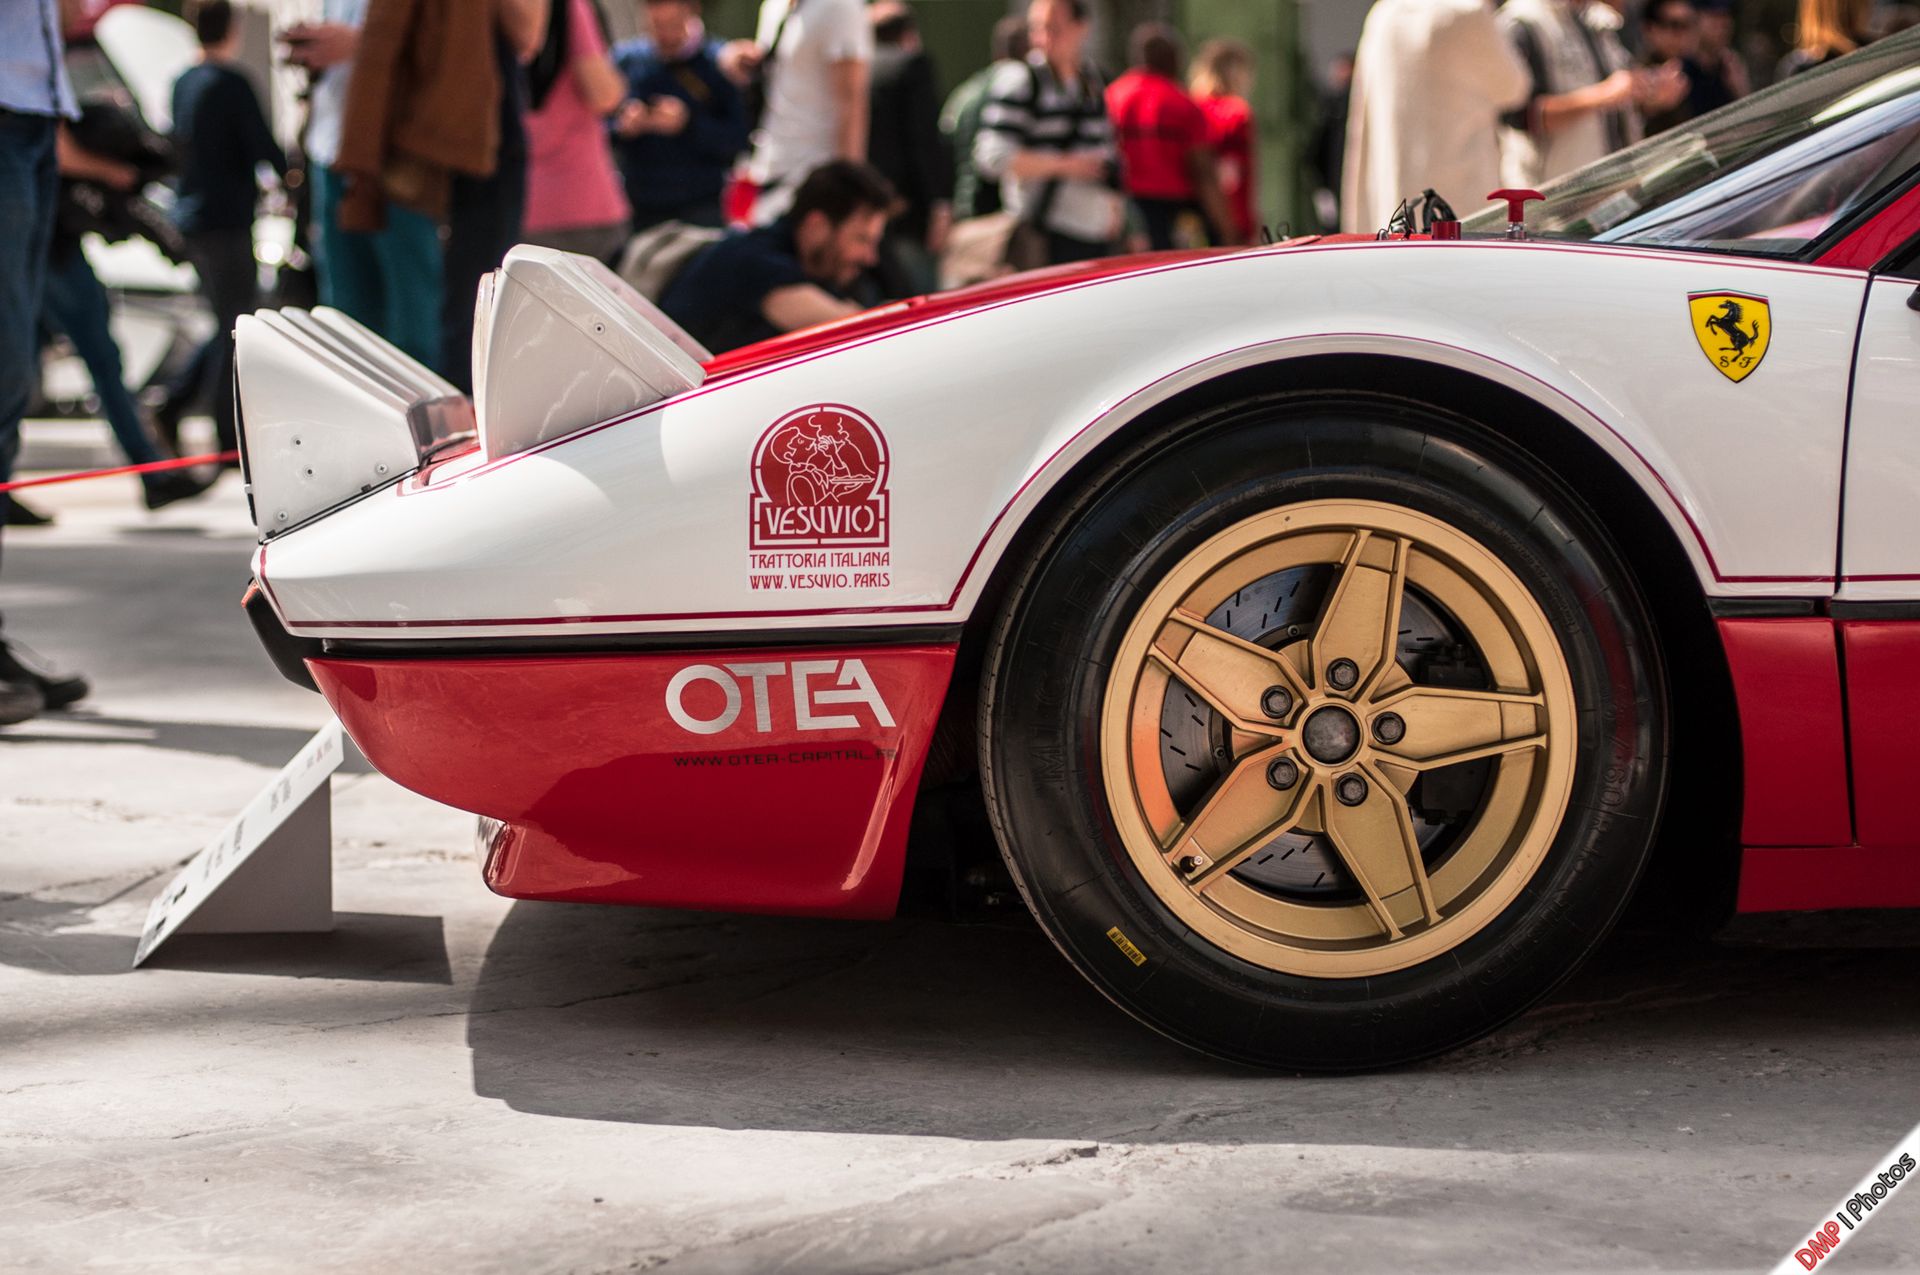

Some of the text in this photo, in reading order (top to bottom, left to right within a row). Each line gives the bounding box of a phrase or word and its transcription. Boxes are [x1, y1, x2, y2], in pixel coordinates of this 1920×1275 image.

[1719, 355, 1730, 368] S
[765, 505, 875, 535] VESUVIO
[749, 551, 890, 569] TRATTORIA ITALIANA
[665, 658, 897, 735] OTEA
